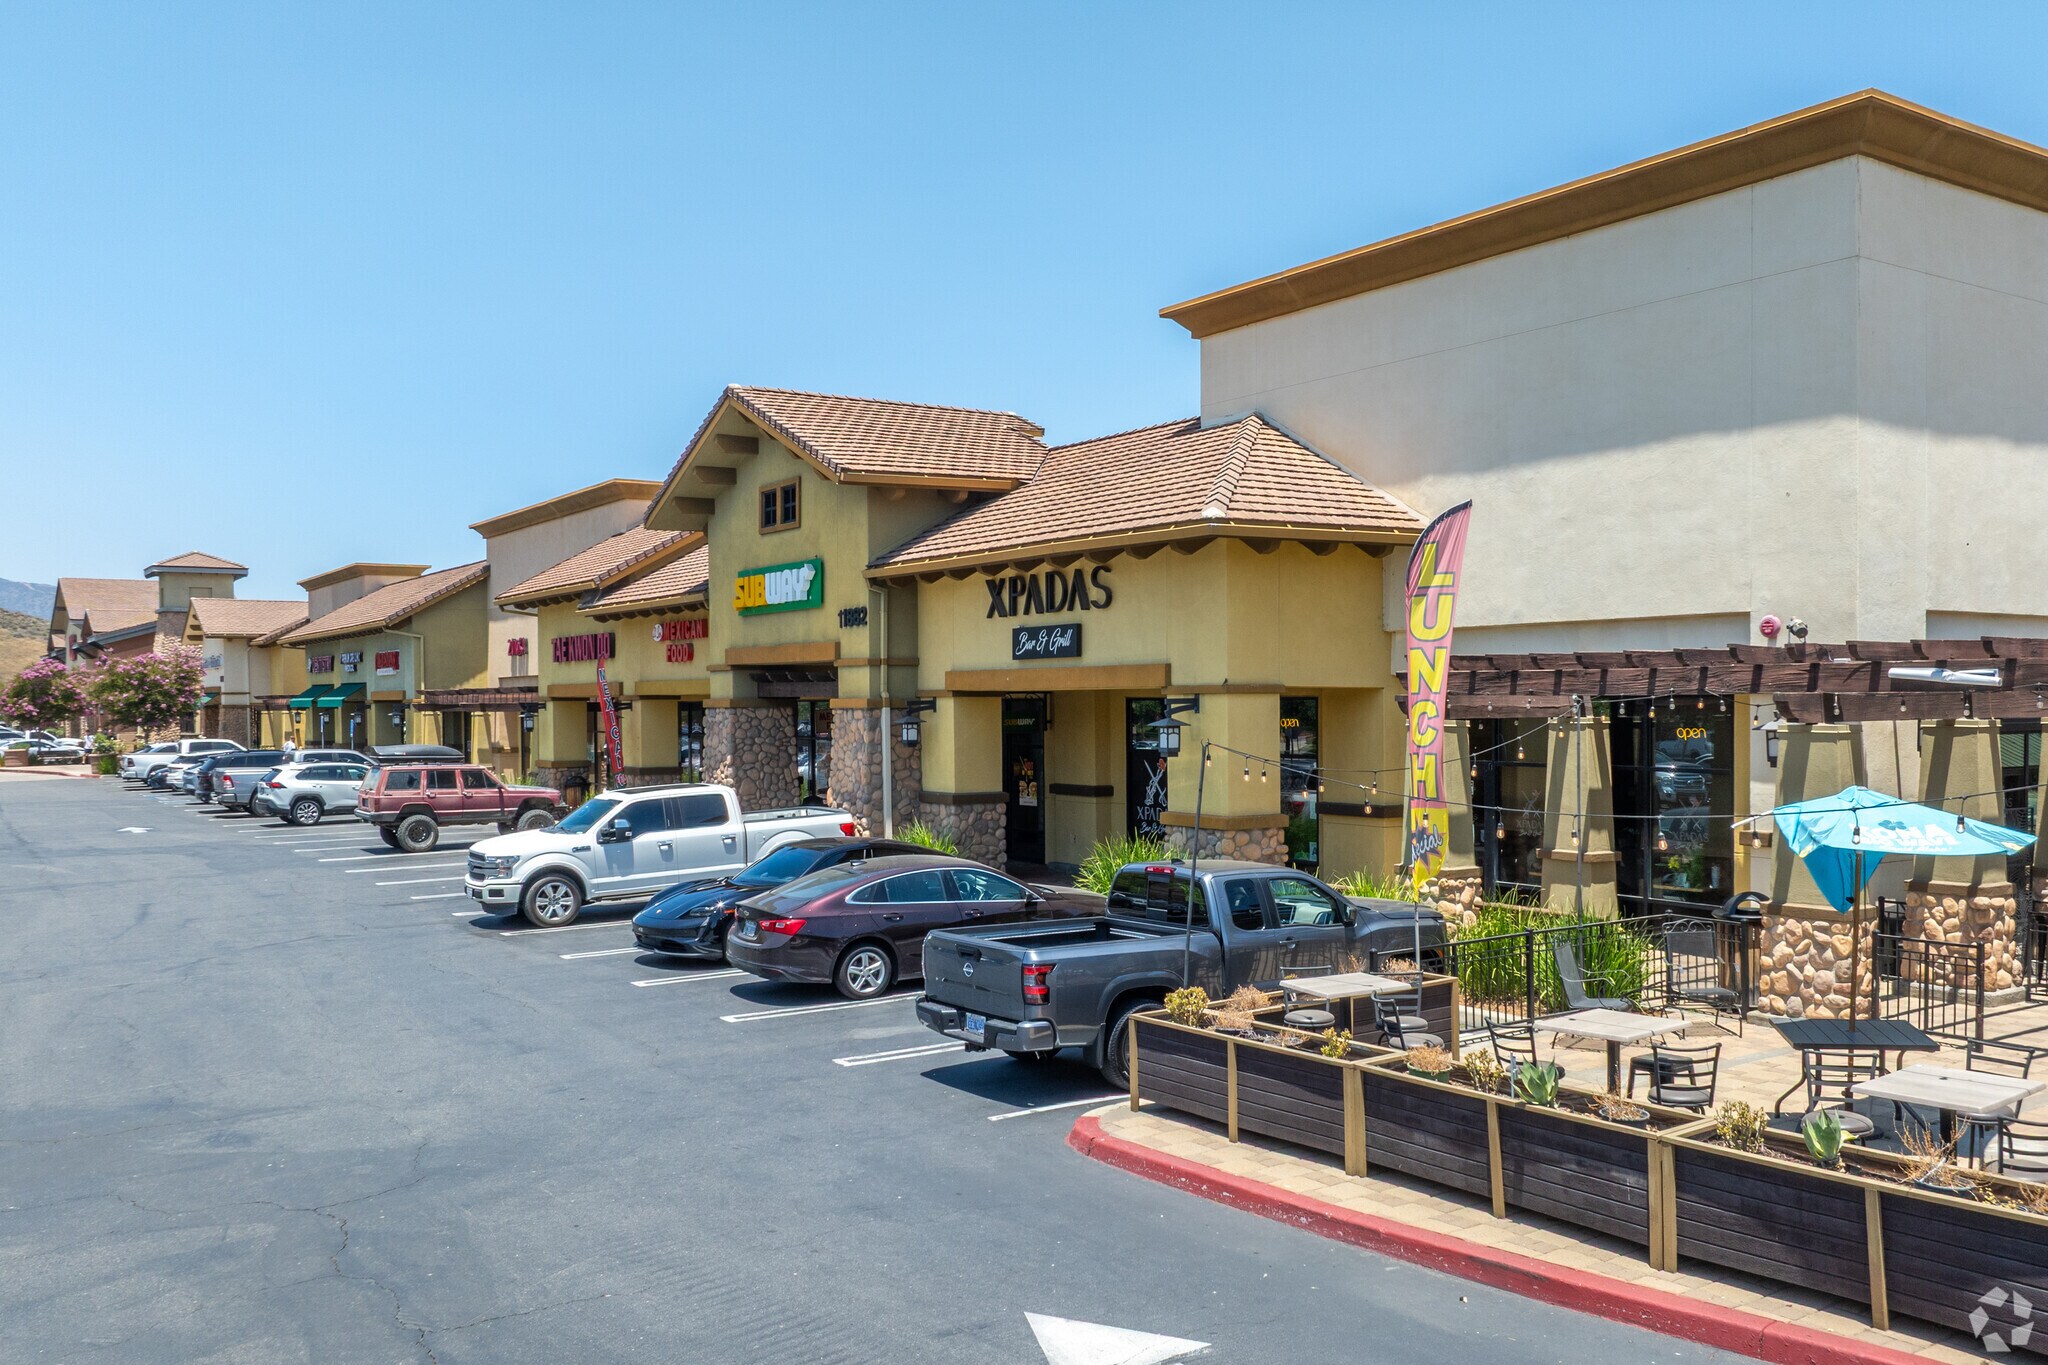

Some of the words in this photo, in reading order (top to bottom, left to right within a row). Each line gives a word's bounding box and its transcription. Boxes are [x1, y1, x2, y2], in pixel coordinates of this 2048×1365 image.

[733, 563, 816, 611] SUBWAY
[985, 565, 1113, 618] XPADAS
[663, 619, 704, 641] MEXICAN
[1015, 631, 1036, 655] Bar
[1036, 629, 1048, 654] &
[1049, 627, 1074, 655] Grill
[551, 637, 567, 662] TAE
[568, 634, 595, 661] KWON
[666, 643, 689, 662] FOOD
[1409, 541, 1456, 800] LUNCH
[1003, 718, 1036, 726] SUBWAY
[1280, 718, 1300, 729] open
[1676, 727, 1707, 741] open
[1411, 823, 1444, 868] pecial
